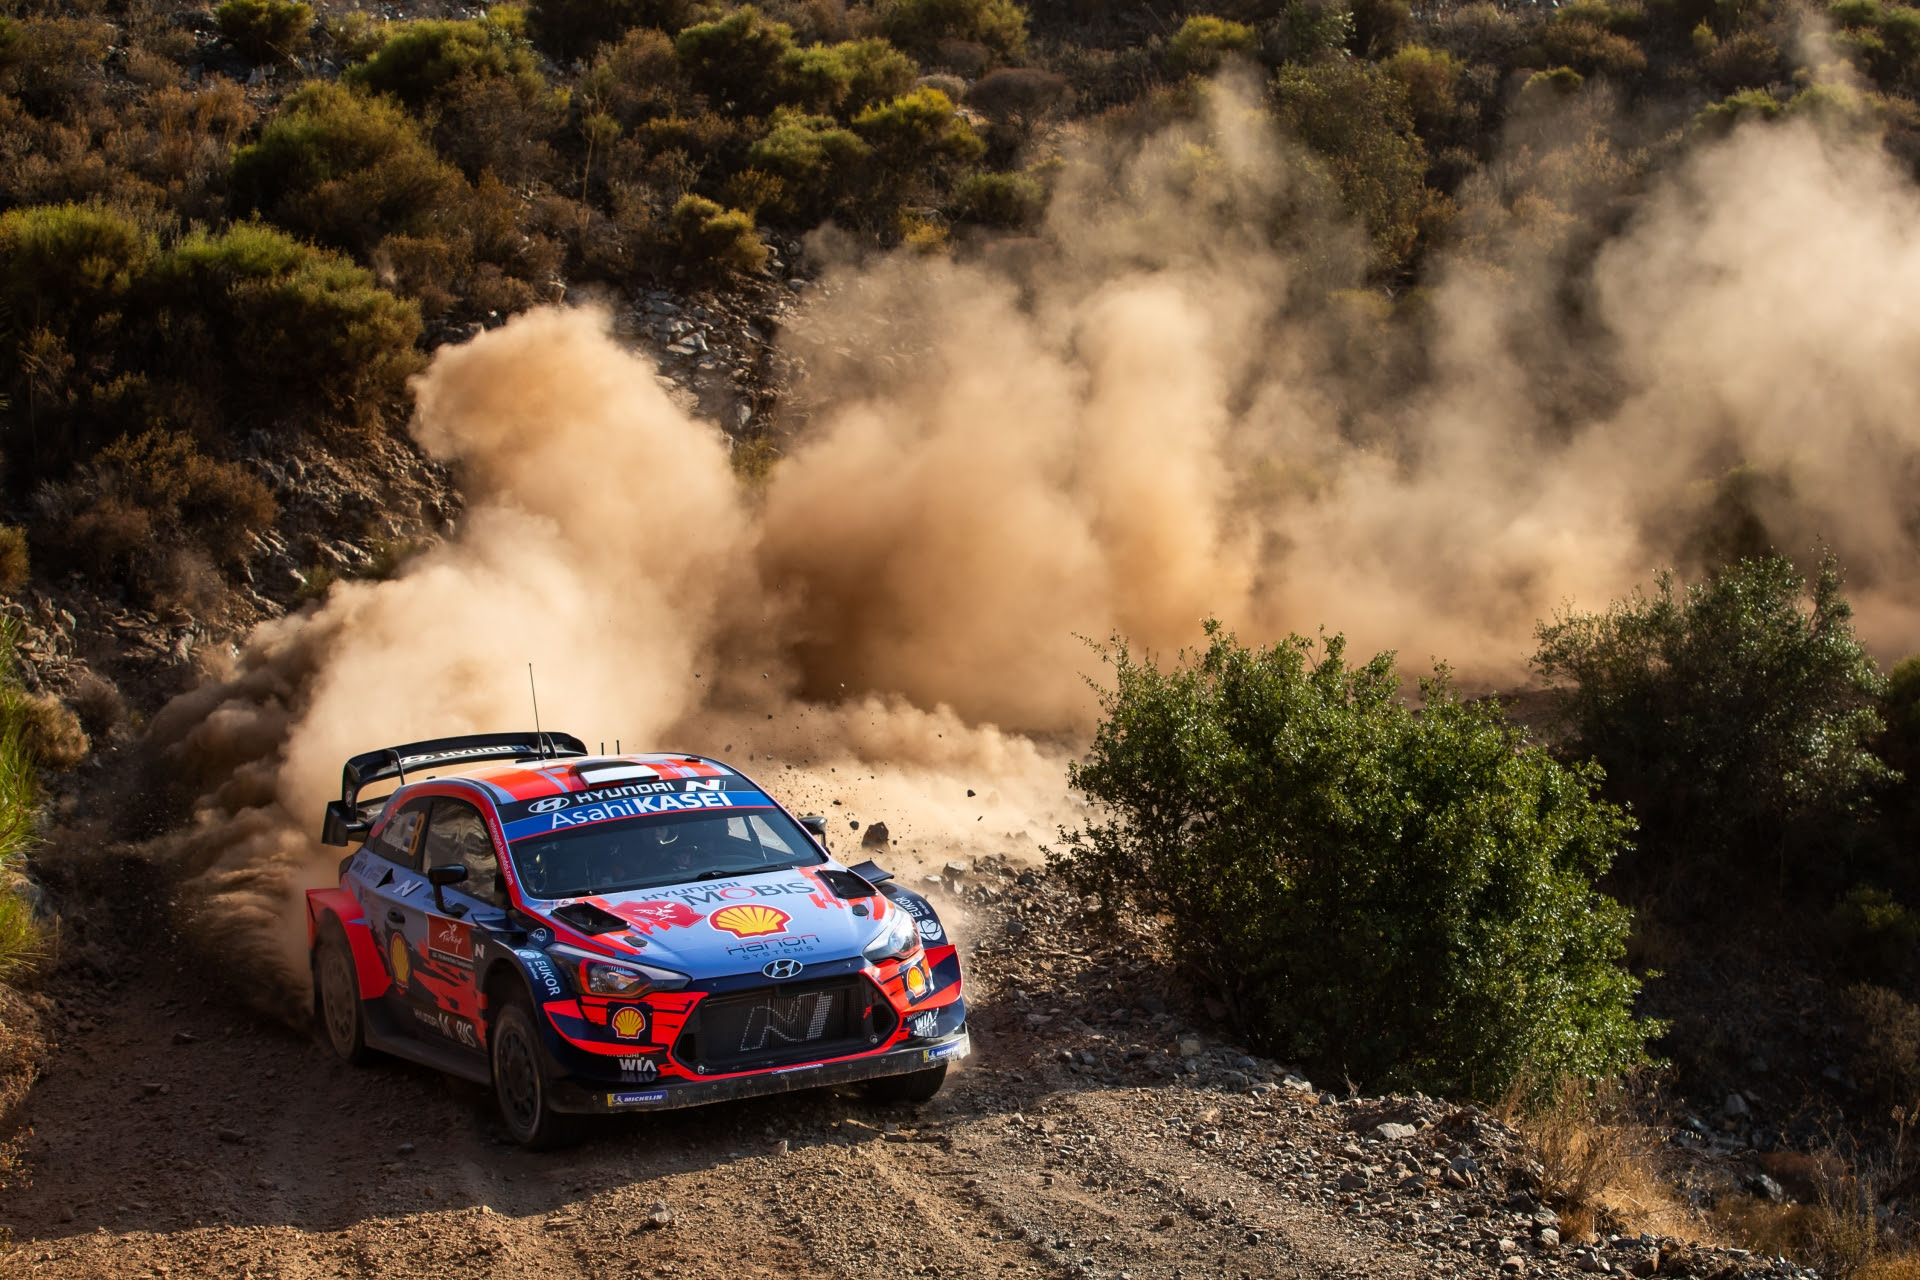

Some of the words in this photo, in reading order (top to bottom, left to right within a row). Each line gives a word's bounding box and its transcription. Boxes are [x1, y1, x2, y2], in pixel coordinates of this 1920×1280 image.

[575, 782, 675, 804] HYUNDAI
[551, 792, 733, 830] AsahiKASEI
[408, 812, 425, 856] 8
[489, 817, 513, 886] motorsport.hyundai.com
[392, 880, 423, 897] N
[641, 881, 740, 902] HYUNDAI
[680, 882, 816, 906] MOBIS
[895, 896, 923, 918] EUKOR
[474, 943, 486, 959] N
[742, 946, 814, 961] SYSTEMS
[534, 960, 561, 997] EUKOR
[624, 1095, 663, 1103] MICHELIN
